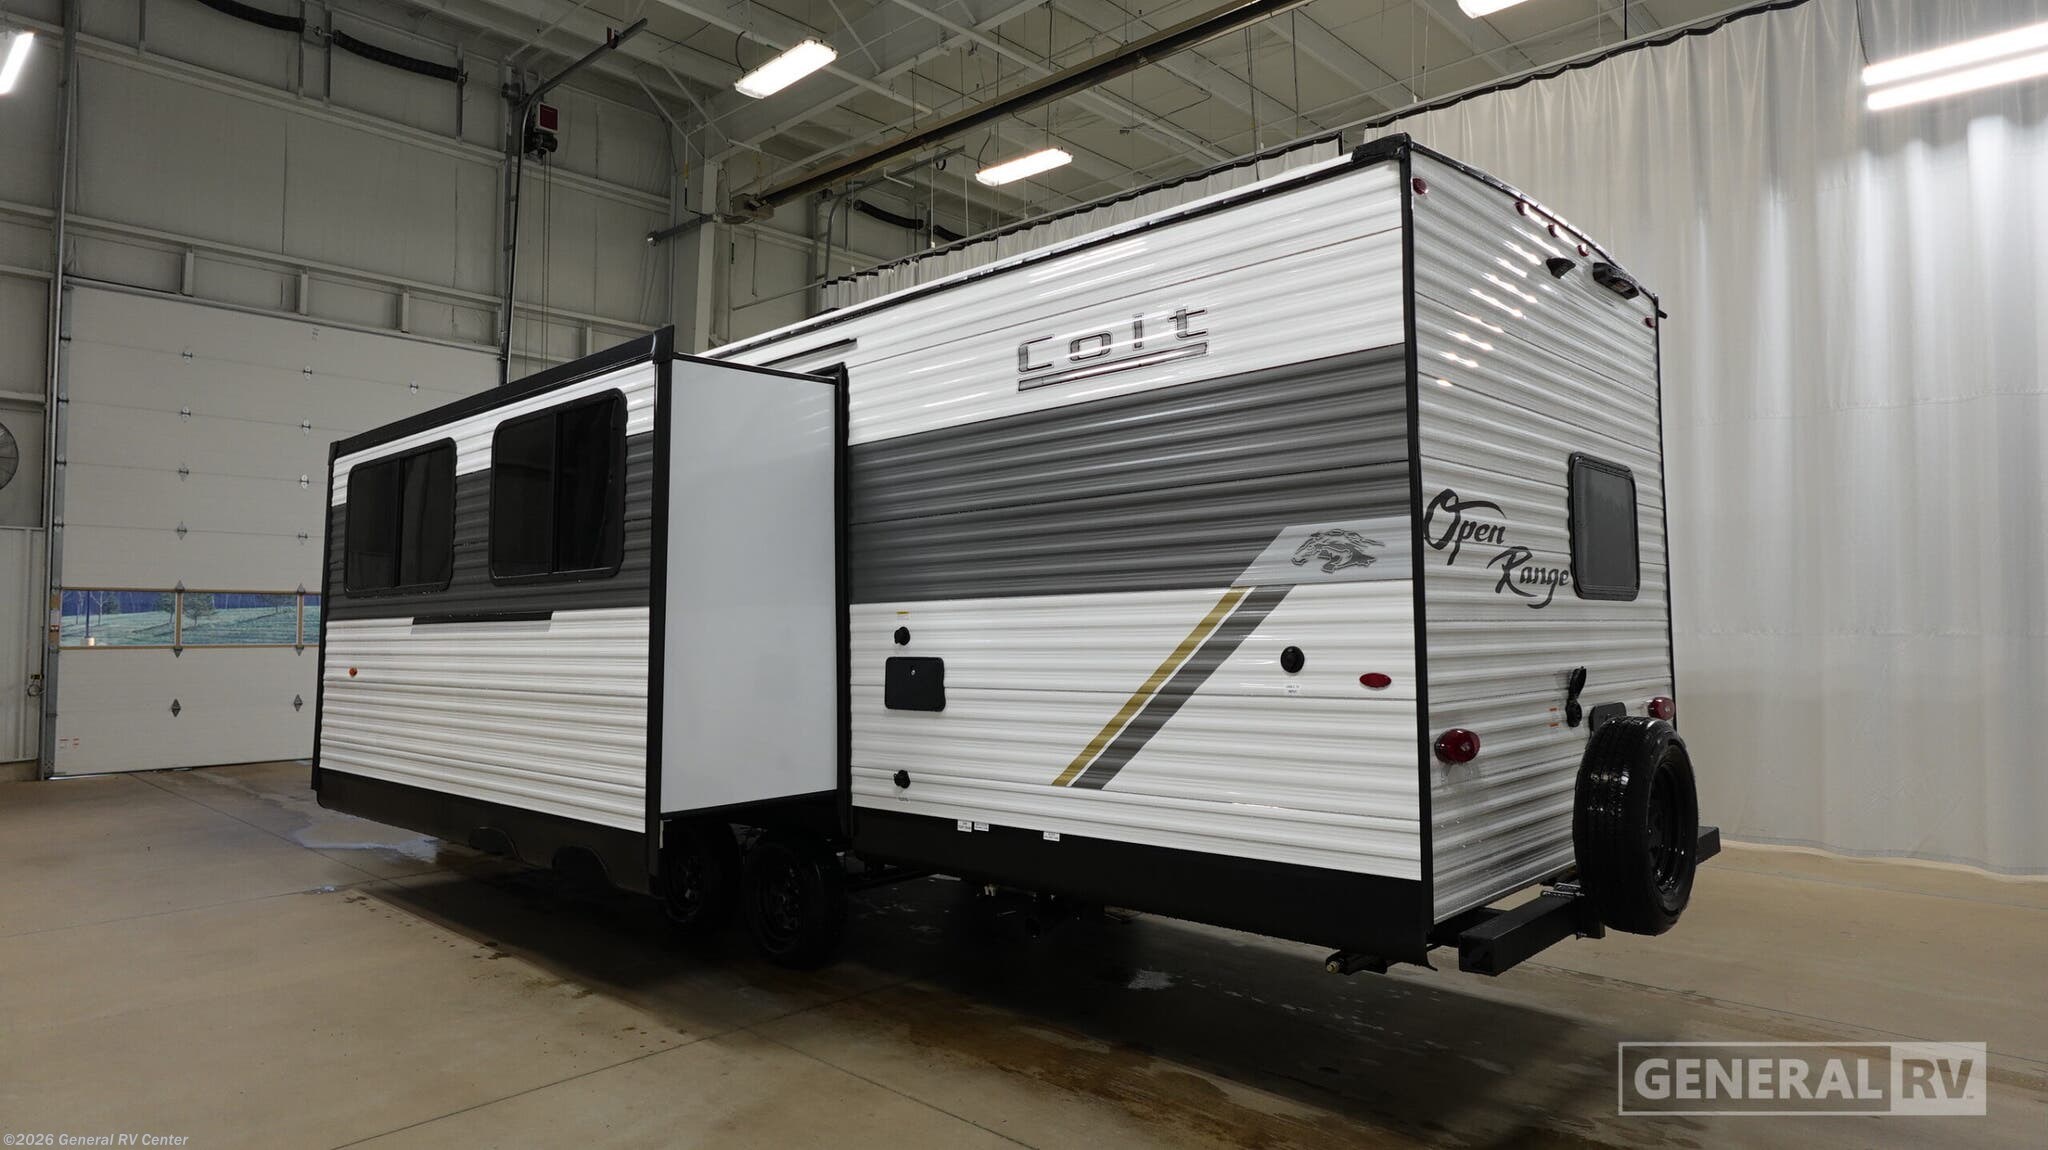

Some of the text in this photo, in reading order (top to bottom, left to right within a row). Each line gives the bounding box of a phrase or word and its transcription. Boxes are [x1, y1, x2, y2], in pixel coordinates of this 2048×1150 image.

[1018, 308, 1209, 373] Colt
[1424, 488, 1507, 566] Open
[1486, 546, 1569, 609] Range
